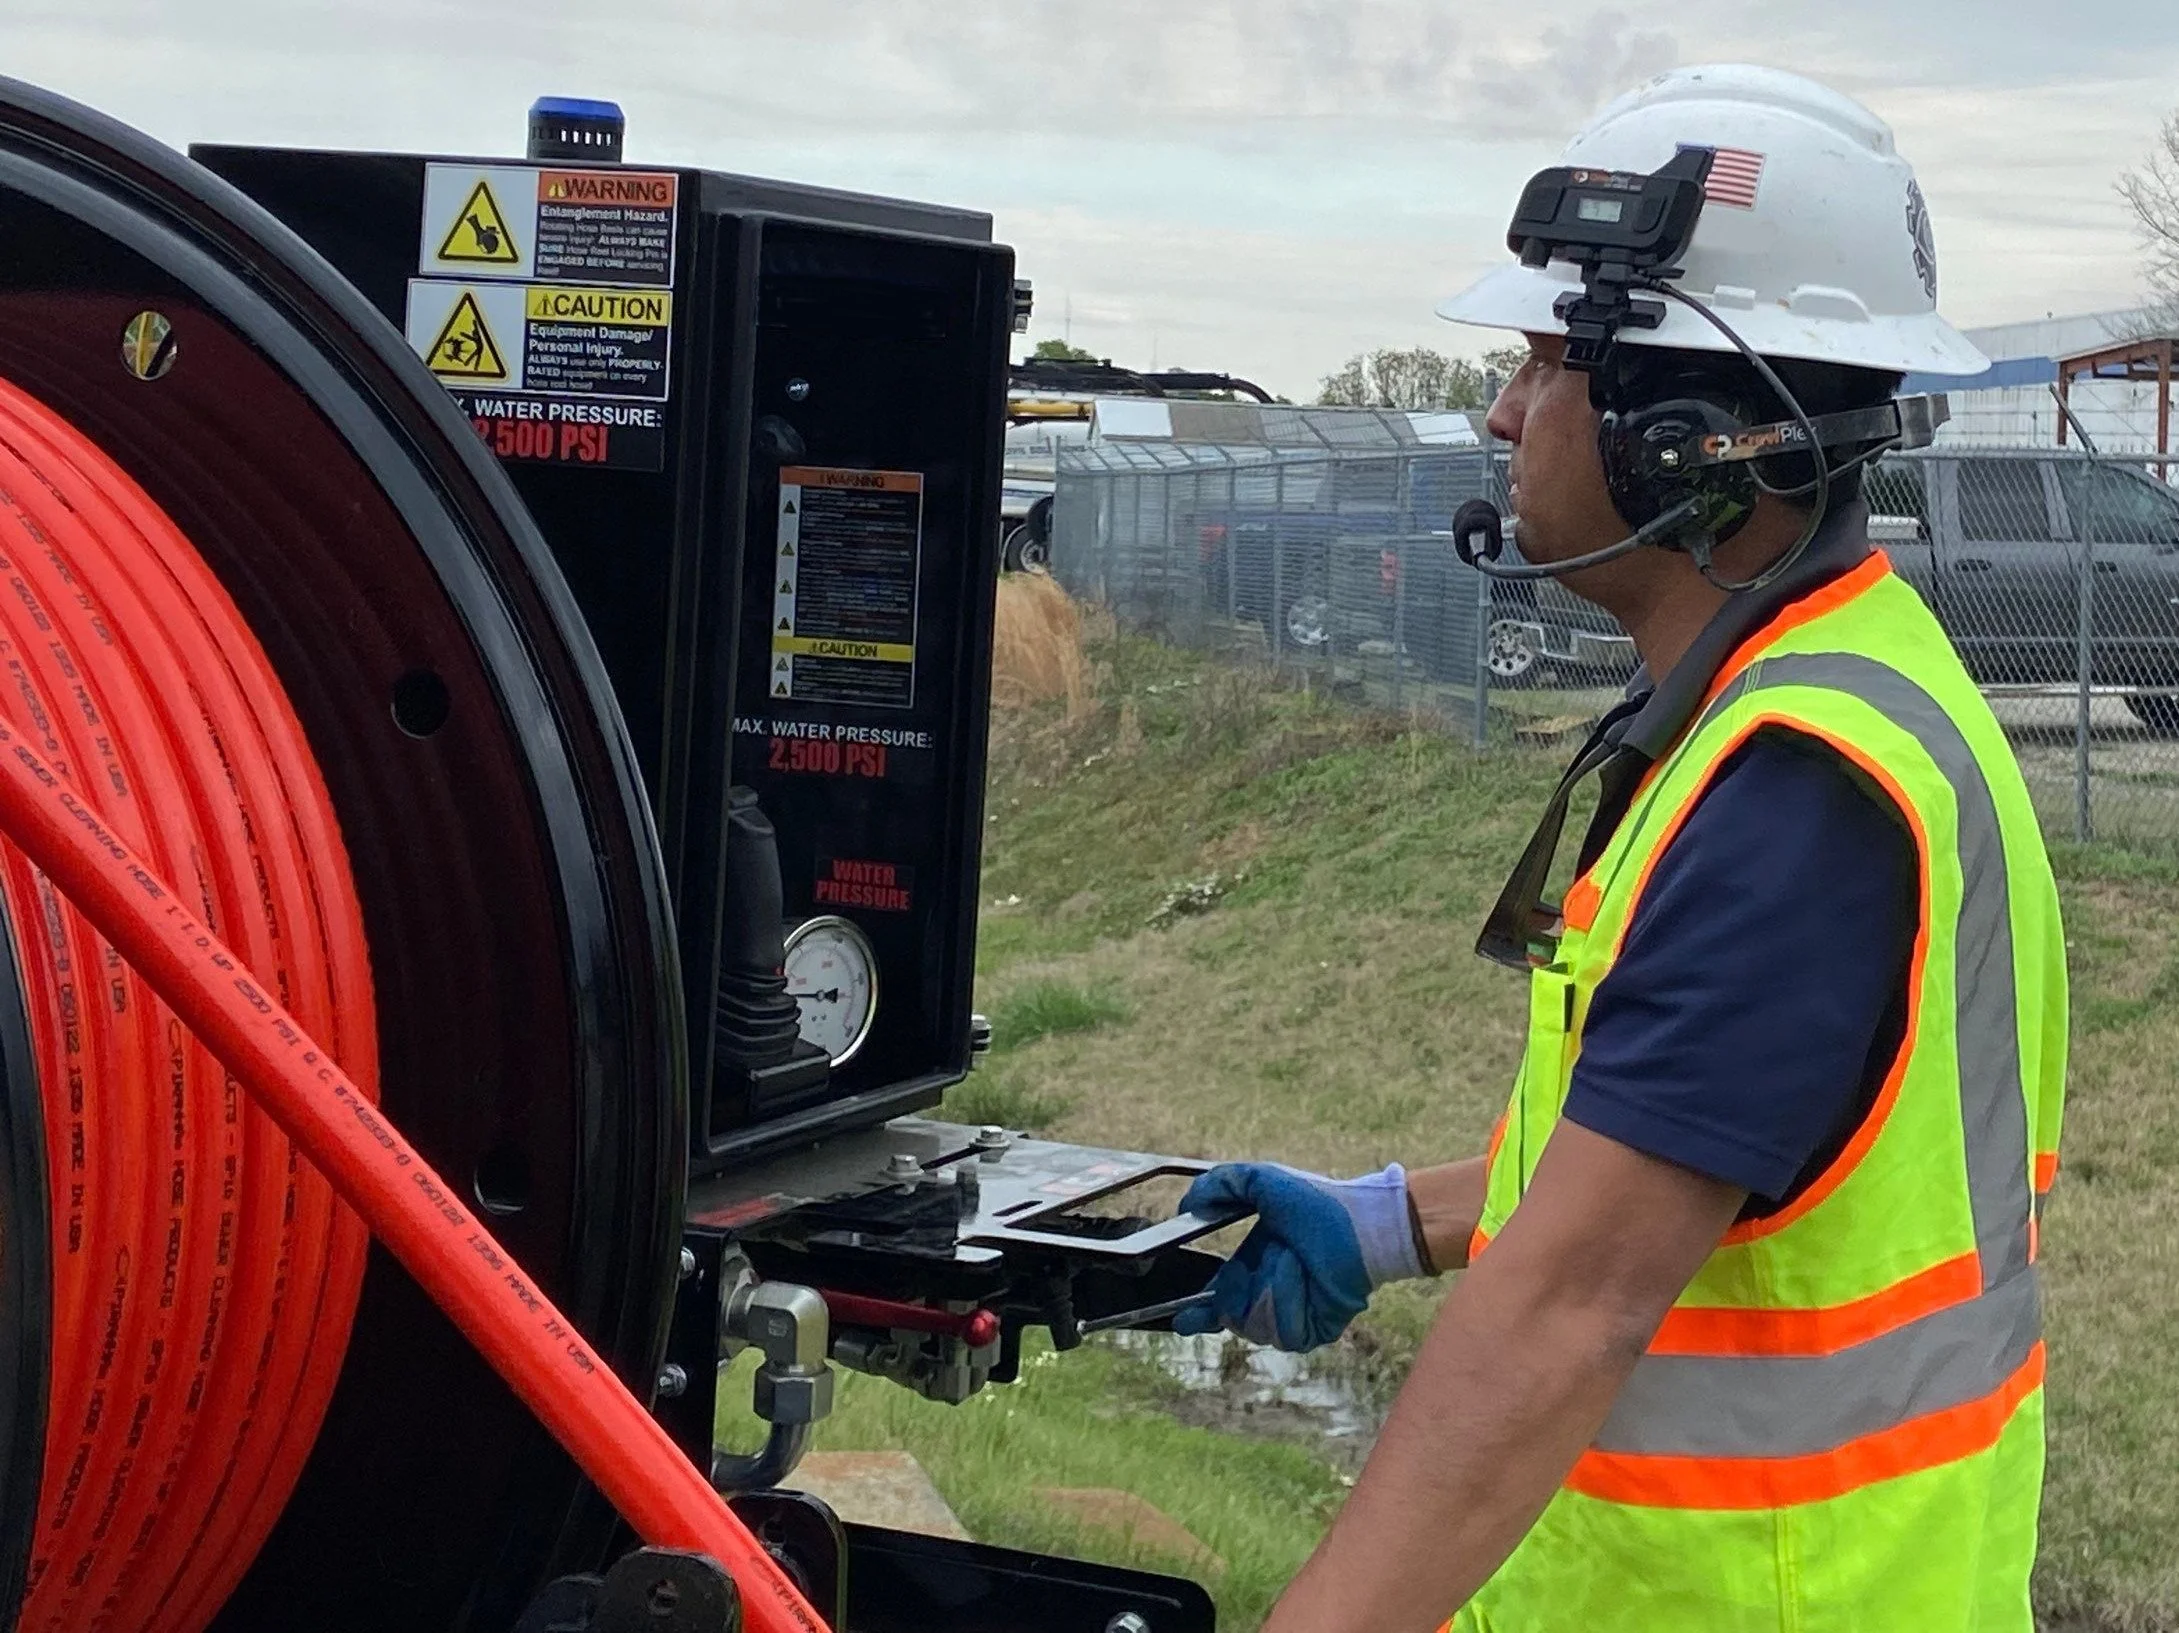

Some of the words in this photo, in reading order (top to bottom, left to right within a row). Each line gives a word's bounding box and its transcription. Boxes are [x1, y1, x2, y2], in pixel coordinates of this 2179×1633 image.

[564, 178, 667, 202] WARNING
[541, 205, 621, 220] Entanglement
[624, 209, 668, 222] Hazard.
[554, 294, 662, 320] CAUTION
[530, 323, 596, 338] Equipment
[599, 326, 654, 344] Damage/
[528, 354, 568, 365] ALWAYS
[529, 339, 583, 353] Personal
[586, 342, 624, 358] Injury.
[527, 366, 560, 376] RATED
[473, 398, 543, 420] WATER
[548, 404, 663, 428] PRESSURE:
[560, 424, 610, 462] PSI
[819, 642, 878, 657] CAUTION
[772, 720, 830, 740] WATER
[835, 724, 934, 748] PRESSURE:
[768, 737, 840, 774] 2,500
[844, 743, 888, 778] PSI
[832, 858, 896, 886] WATER
[815, 880, 911, 911] PRESSURE
[60, 792, 128, 860] CLEANING
[233, 978, 272, 1013] 2500
[271, 1018, 301, 1046] PSI
[542, 1319, 566, 1340] IN
[566, 1342, 595, 1374] USA
